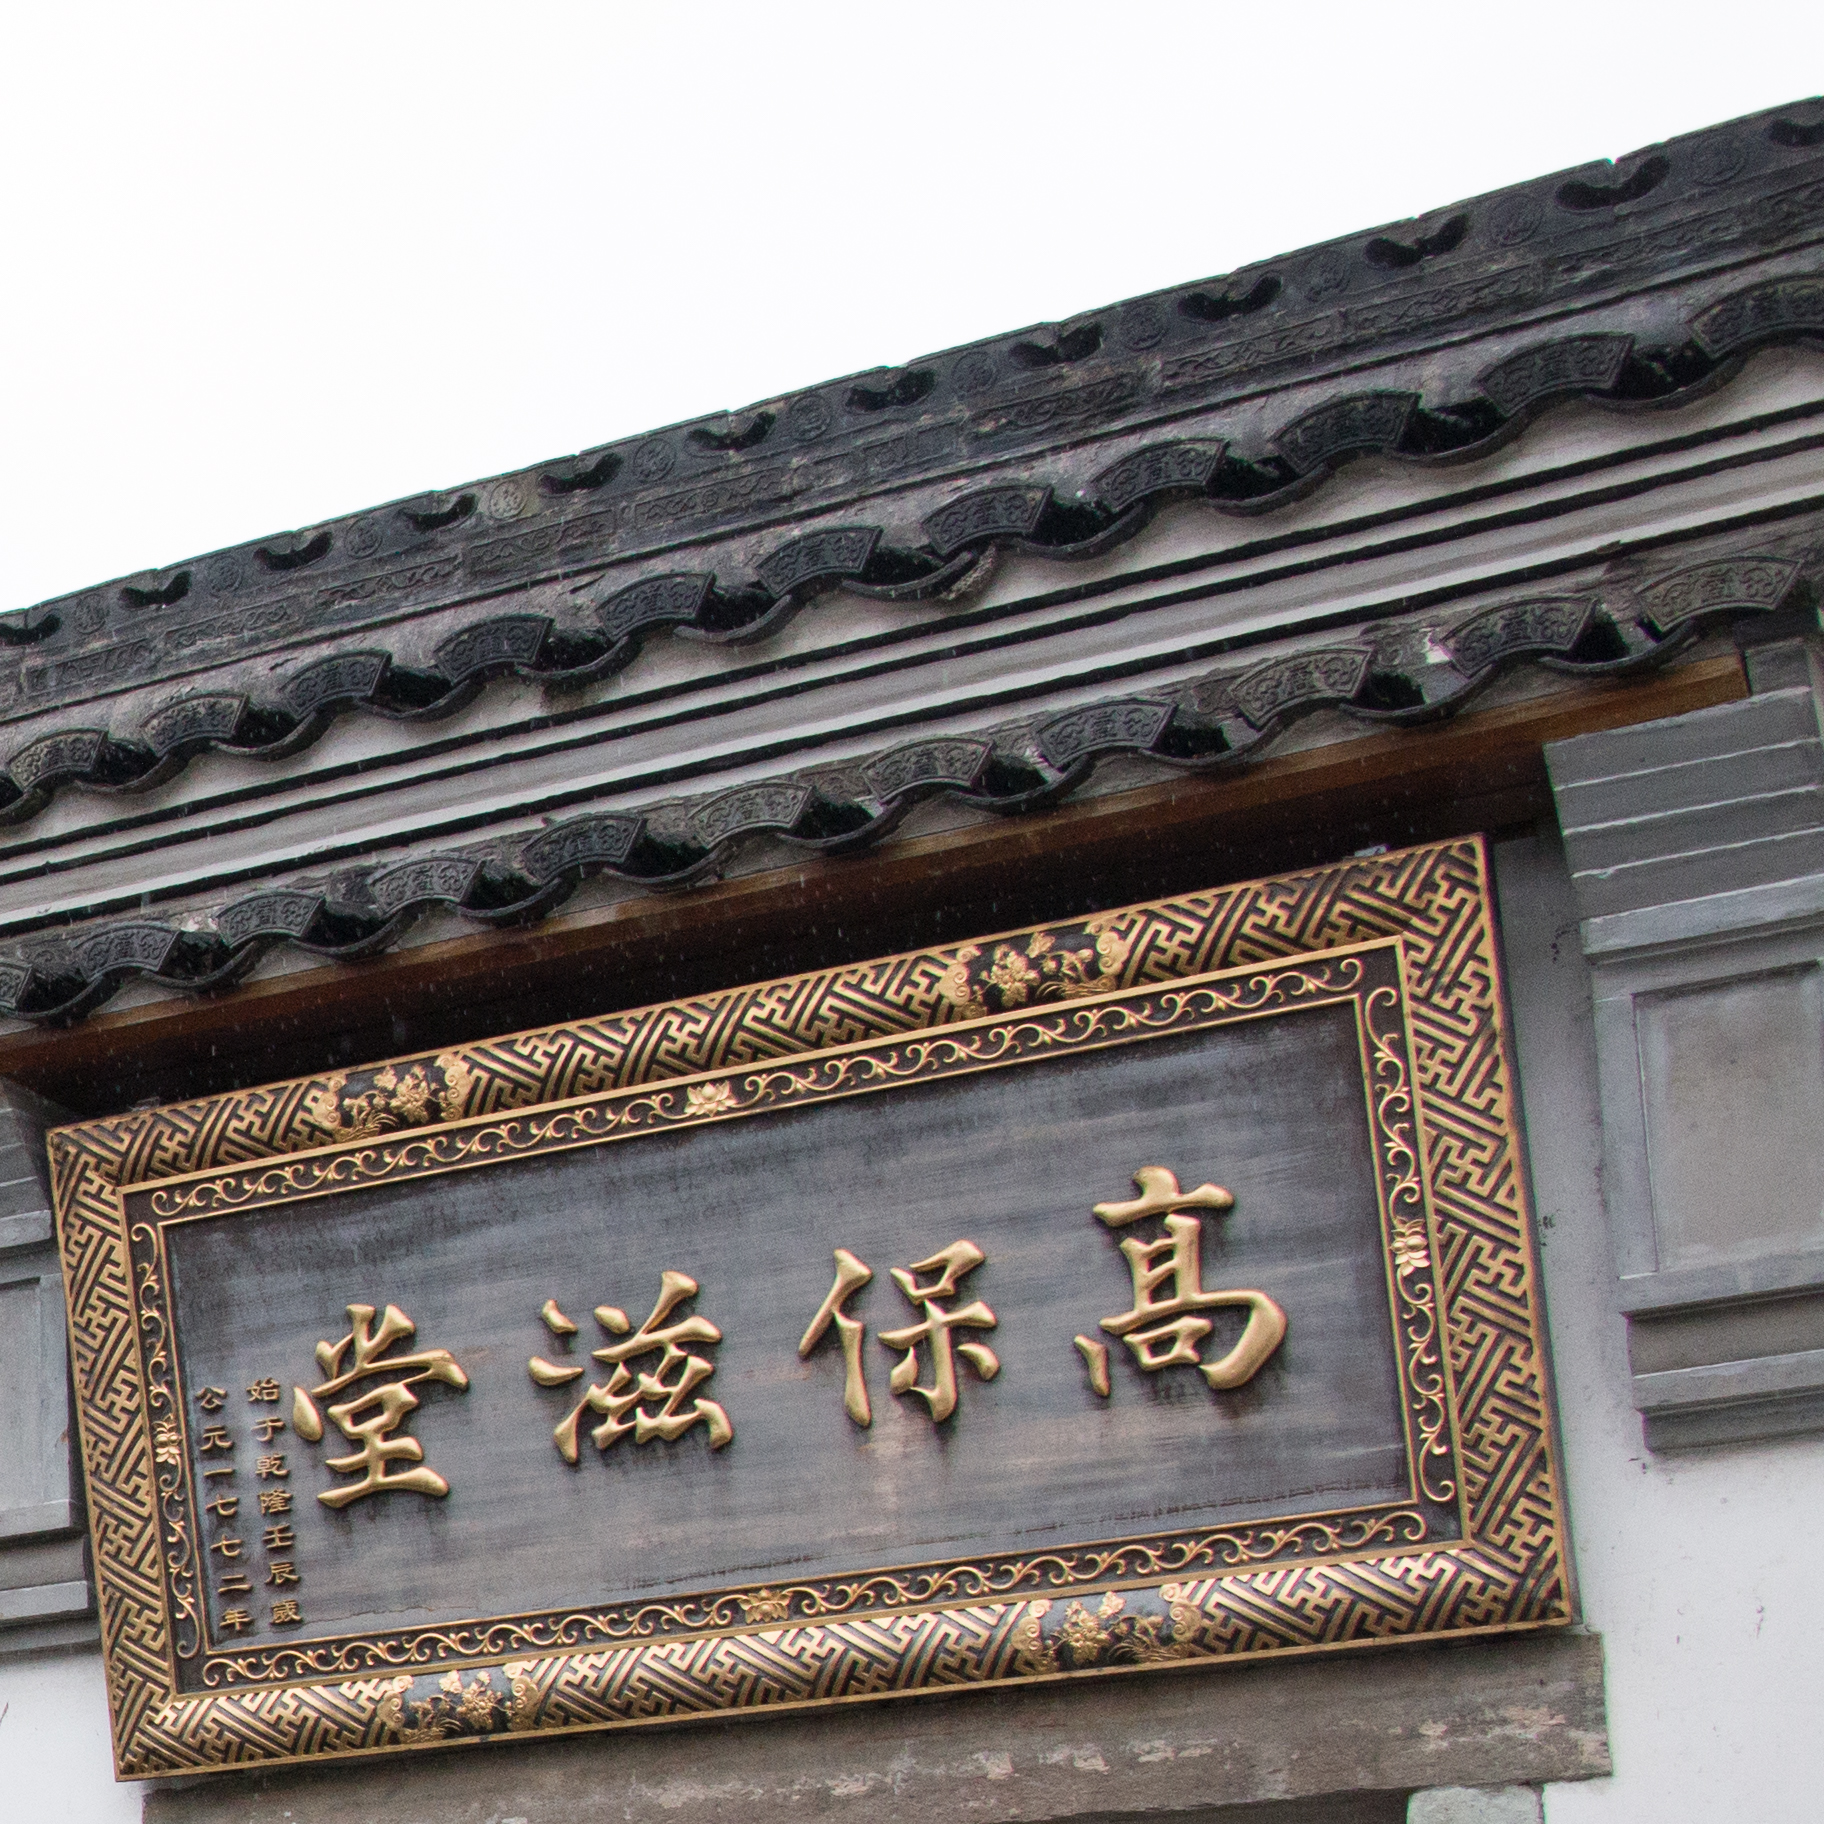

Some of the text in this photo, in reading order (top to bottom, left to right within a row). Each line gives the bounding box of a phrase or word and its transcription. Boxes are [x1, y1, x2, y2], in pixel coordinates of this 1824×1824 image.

[292, 1165, 1288, 1509] 高保滋堂
[195, 1386, 253, 1632] 公元一七七二年
[246, 1377, 302, 1625] 始于乾隆壬辰歲
